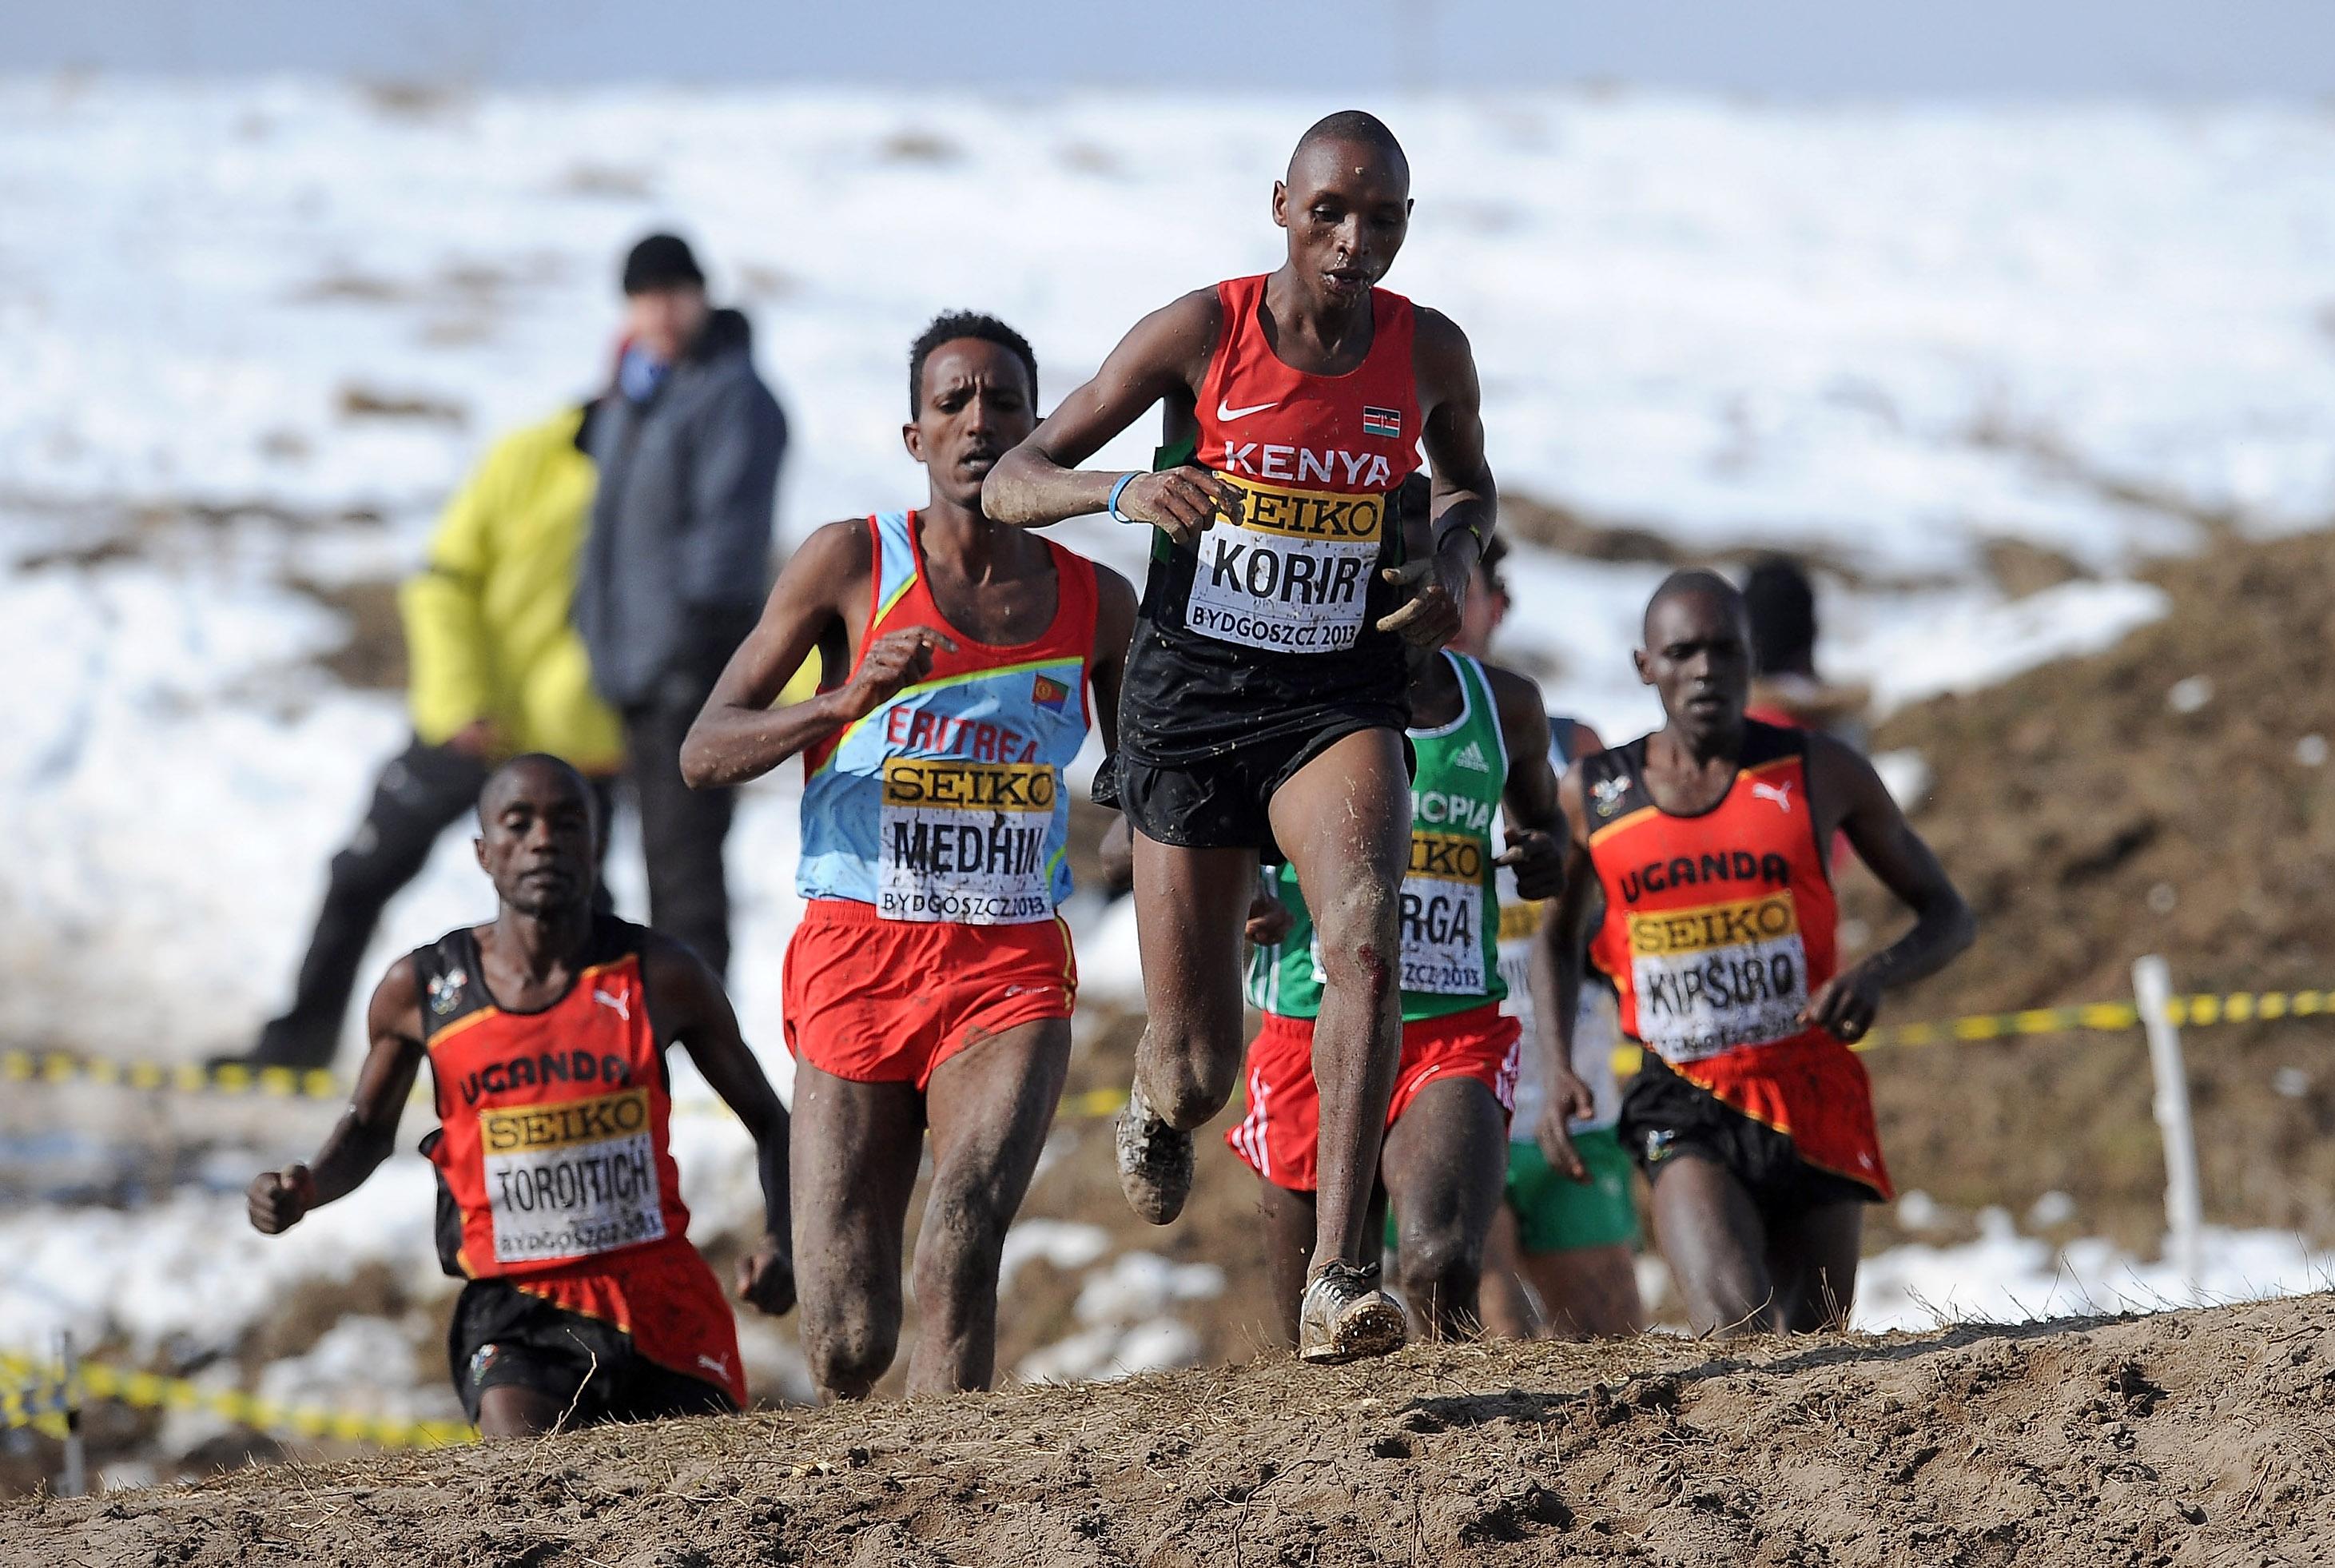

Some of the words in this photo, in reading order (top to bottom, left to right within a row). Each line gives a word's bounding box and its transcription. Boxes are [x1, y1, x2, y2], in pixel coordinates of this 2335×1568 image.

[1225, 440, 1390, 487] KENYA
[1243, 490, 1378, 537] EIKO
[1211, 539, 1362, 605] KORIR
[1191, 605, 1317, 647] BYDGOSZCZ
[1319, 625, 1357, 647] 2013
[887, 705, 1037, 764] ERITREA
[889, 766, 1052, 806] SEIKO
[1410, 790, 1490, 834] IOPIA
[1408, 839, 1479, 878] IKO
[1621, 851, 1789, 903] UGANDA
[1399, 893, 1471, 949] RGA
[1633, 900, 1790, 952] SEIKO
[460, 1048, 631, 1105] UGANDA
[491, 1097, 644, 1150] SEIKO
